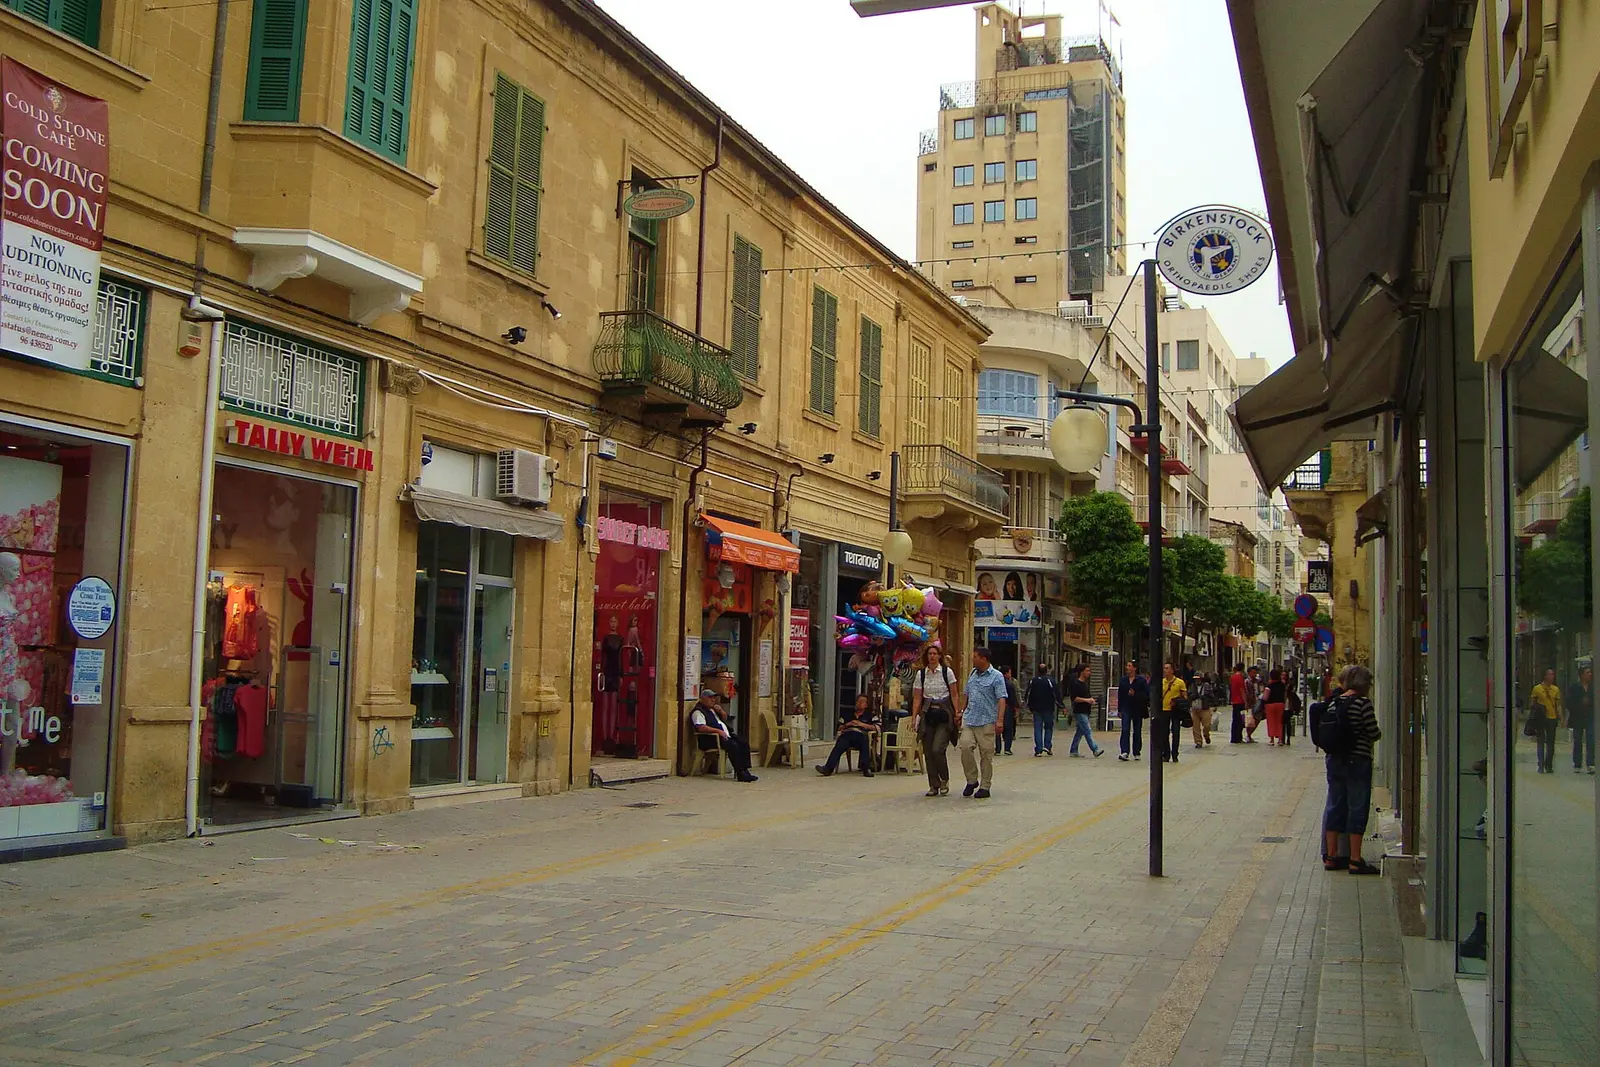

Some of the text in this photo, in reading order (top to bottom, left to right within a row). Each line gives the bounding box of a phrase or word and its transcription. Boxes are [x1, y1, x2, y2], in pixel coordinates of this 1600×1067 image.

[5, 92, 106, 147] COLD STONE
[37, 123, 77, 151] CAFÉ
[5, 139, 105, 194] COMING
[30, 235, 65, 257] NOW
[1163, 213, 1266, 248] BIRKENSTOCK
[2, 244, 92, 285] UDITIONING
[1163, 256, 1266, 291] ORTHOPAEDIC SHOES
[24, 272, 50, 290] μέλος
[52, 281, 66, 295] της
[234, 419, 306, 457] TALLY
[598, 516, 670, 551] SWEET BABE
[1309, 568, 1327, 576] PULL
[1309, 583, 1328, 591] BEAR
[1313, 576, 1328, 584] AND
[599, 597, 653, 610] sweet babe
